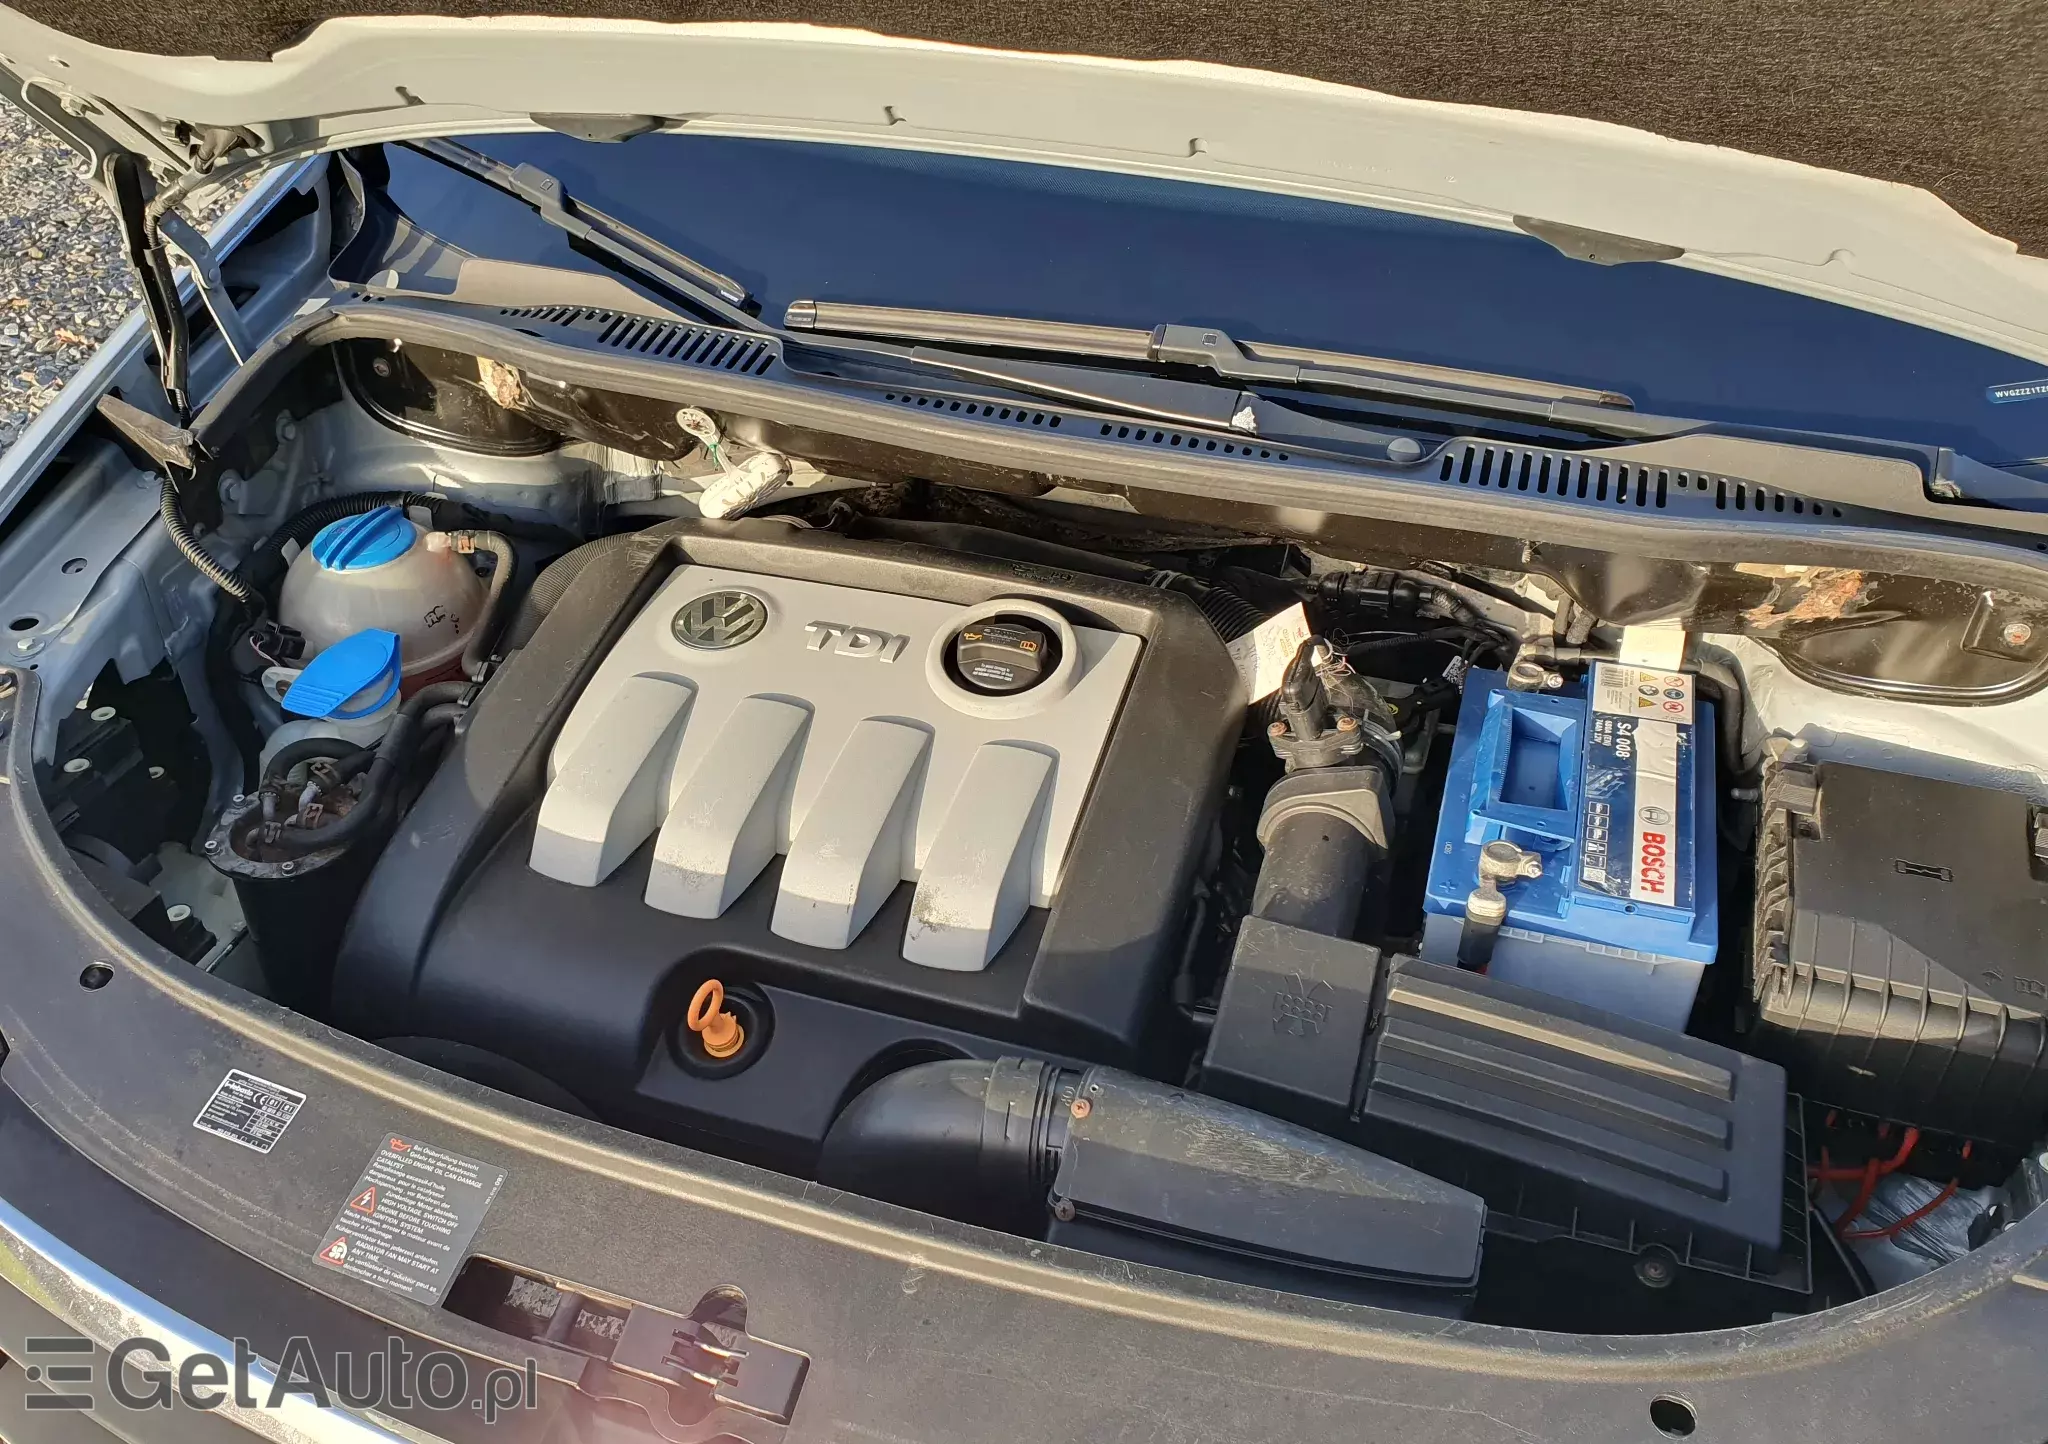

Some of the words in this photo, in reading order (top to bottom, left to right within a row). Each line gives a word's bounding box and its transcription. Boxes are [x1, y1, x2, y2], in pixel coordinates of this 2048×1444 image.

[804, 620, 911, 664] TDI
[1616, 721, 1632, 737] S4
[1615, 737, 1631, 758] 008
[1640, 832, 1666, 894] BOSCH
[409, 1152, 427, 1161] Gefahr
[380, 1151, 412, 1165] OVERFILLED
[413, 1161, 433, 1172] ENGINE
[445, 1171, 457, 1179] CAN
[457, 1176, 482, 1187] DAMAGE
[398, 1179, 410, 1187] pour
[381, 1198, 396, 1207] HIGH
[423, 1212, 446, 1224] SWITCH
[447, 1220, 458, 1228] OFF
[417, 1201, 433, 1210] Motor
[340, 1217, 359, 1227] toucher
[373, 1213, 398, 1224] IGNITION
[377, 1205, 397, 1216] ENGINE
[399, 1213, 420, 1224] BEFORE
[421, 1220, 451, 1234] TOUCHING
[377, 1239, 390, 1248] kann
[391, 1244, 414, 1257] jederzeit
[407, 1232, 426, 1242] moteur
[427, 1239, 442, 1248] avant
[352, 1248, 364, 1256] ANY
[356, 1241, 384, 1254] RADIATOR
[411, 1260, 429, 1270] START
[354, 1258, 382, 1272] ventilateur
[391, 1271, 415, 1284] radiateur
[416, 1280, 429, 1289] peut
[377, 1275, 388, 1283] tout
